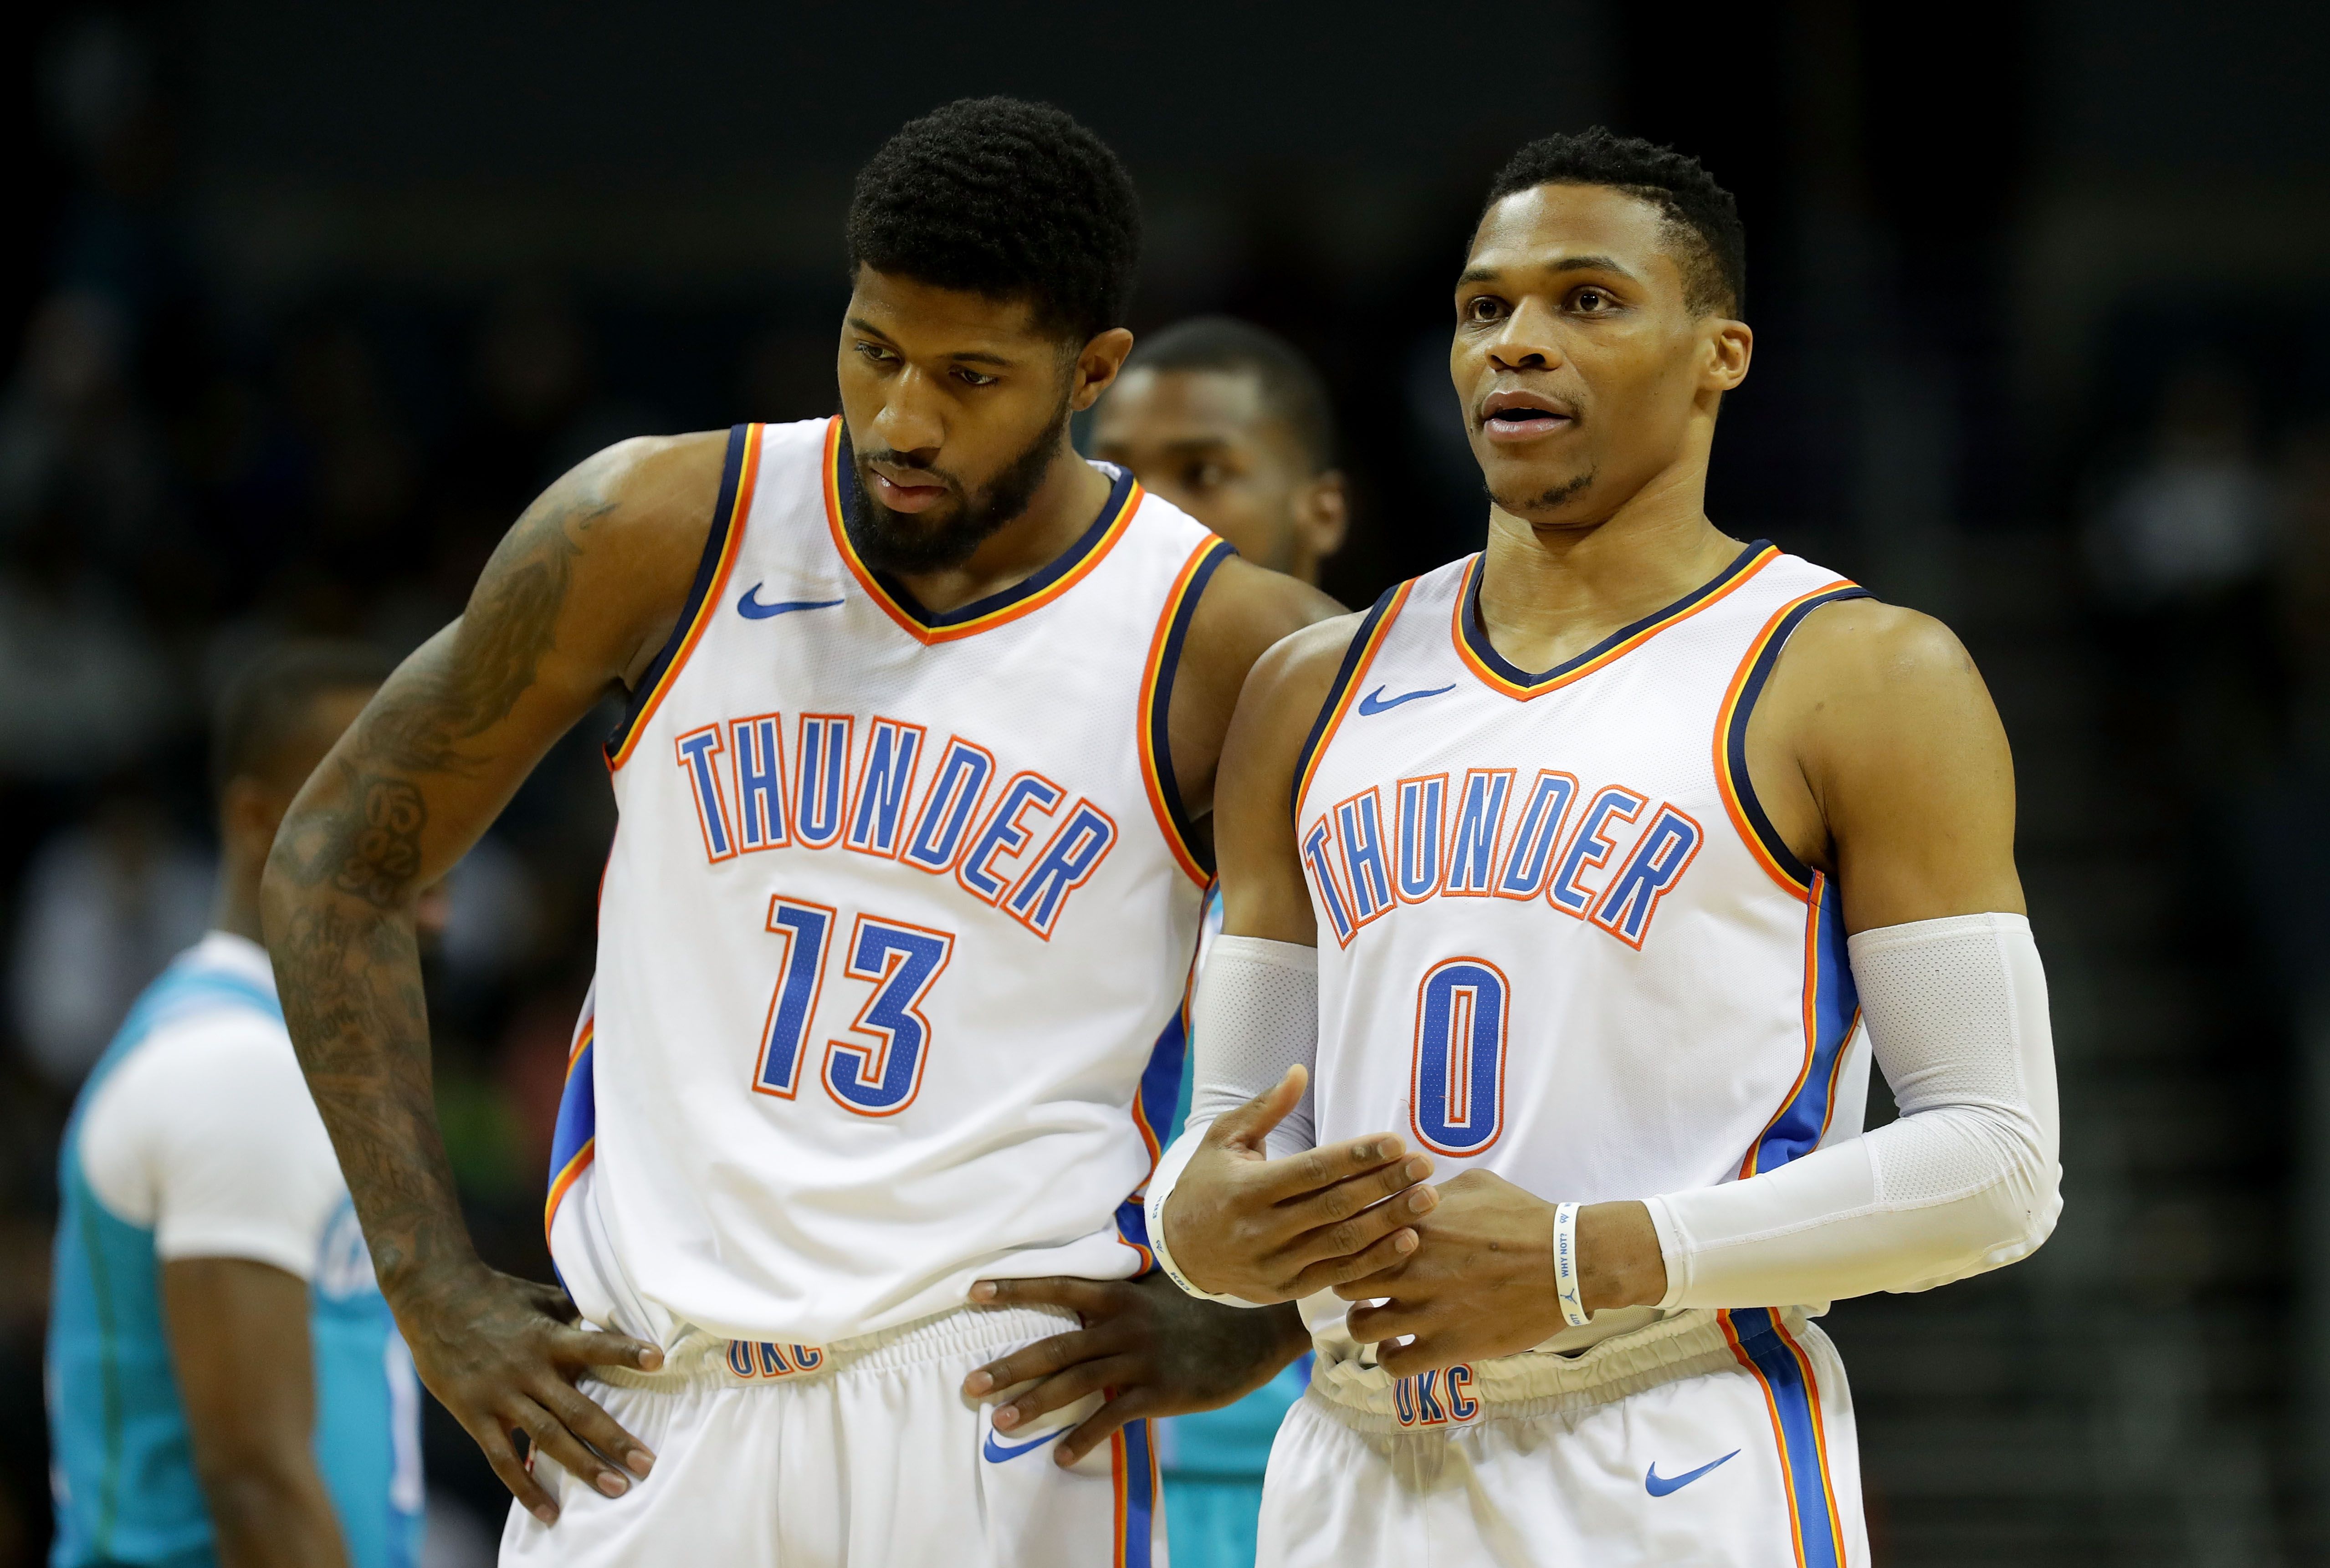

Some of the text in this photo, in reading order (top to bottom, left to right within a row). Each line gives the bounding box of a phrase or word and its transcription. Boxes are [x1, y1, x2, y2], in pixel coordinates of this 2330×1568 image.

[675, 712, 1117, 942] THUNDER
[1302, 768, 1704, 952] THUNDER
[752, 894, 955, 1117] 13
[1410, 956, 1511, 1158] 0
[1171, 1272, 1190, 1291] KB3
[1560, 1258, 1569, 1277] WHY
[1393, 1363, 1479, 1427] OKC
